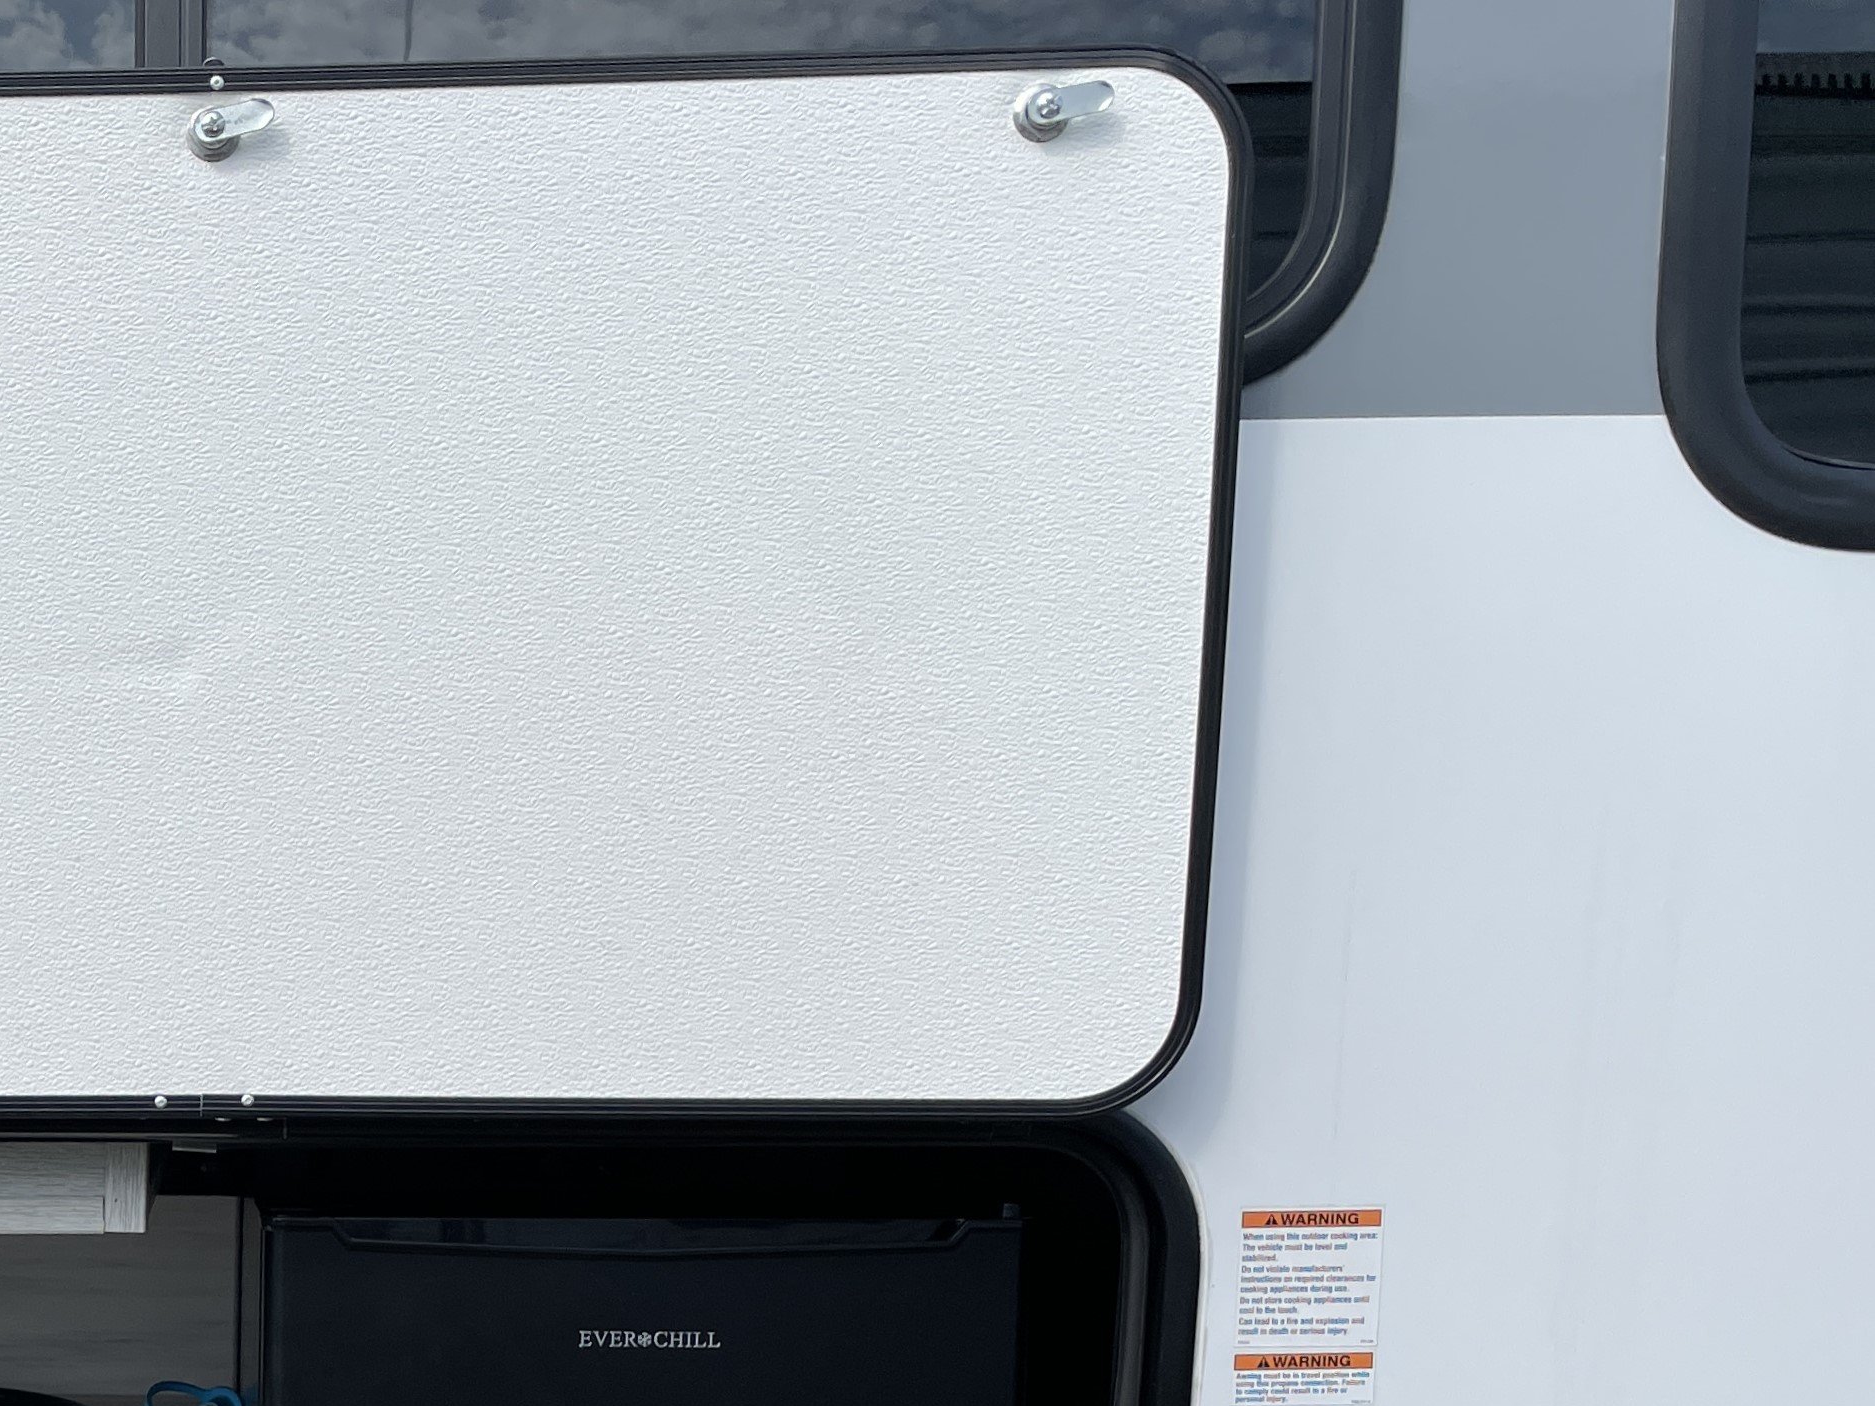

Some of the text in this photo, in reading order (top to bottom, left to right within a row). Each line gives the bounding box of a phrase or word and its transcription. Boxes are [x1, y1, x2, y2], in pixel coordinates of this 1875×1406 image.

[1281, 1213, 1358, 1225] WARNING
[1266, 1233, 1284, 1241] using
[579, 1330, 720, 1348] EVER CHILL
[1273, 1355, 1351, 1367] WARNING
